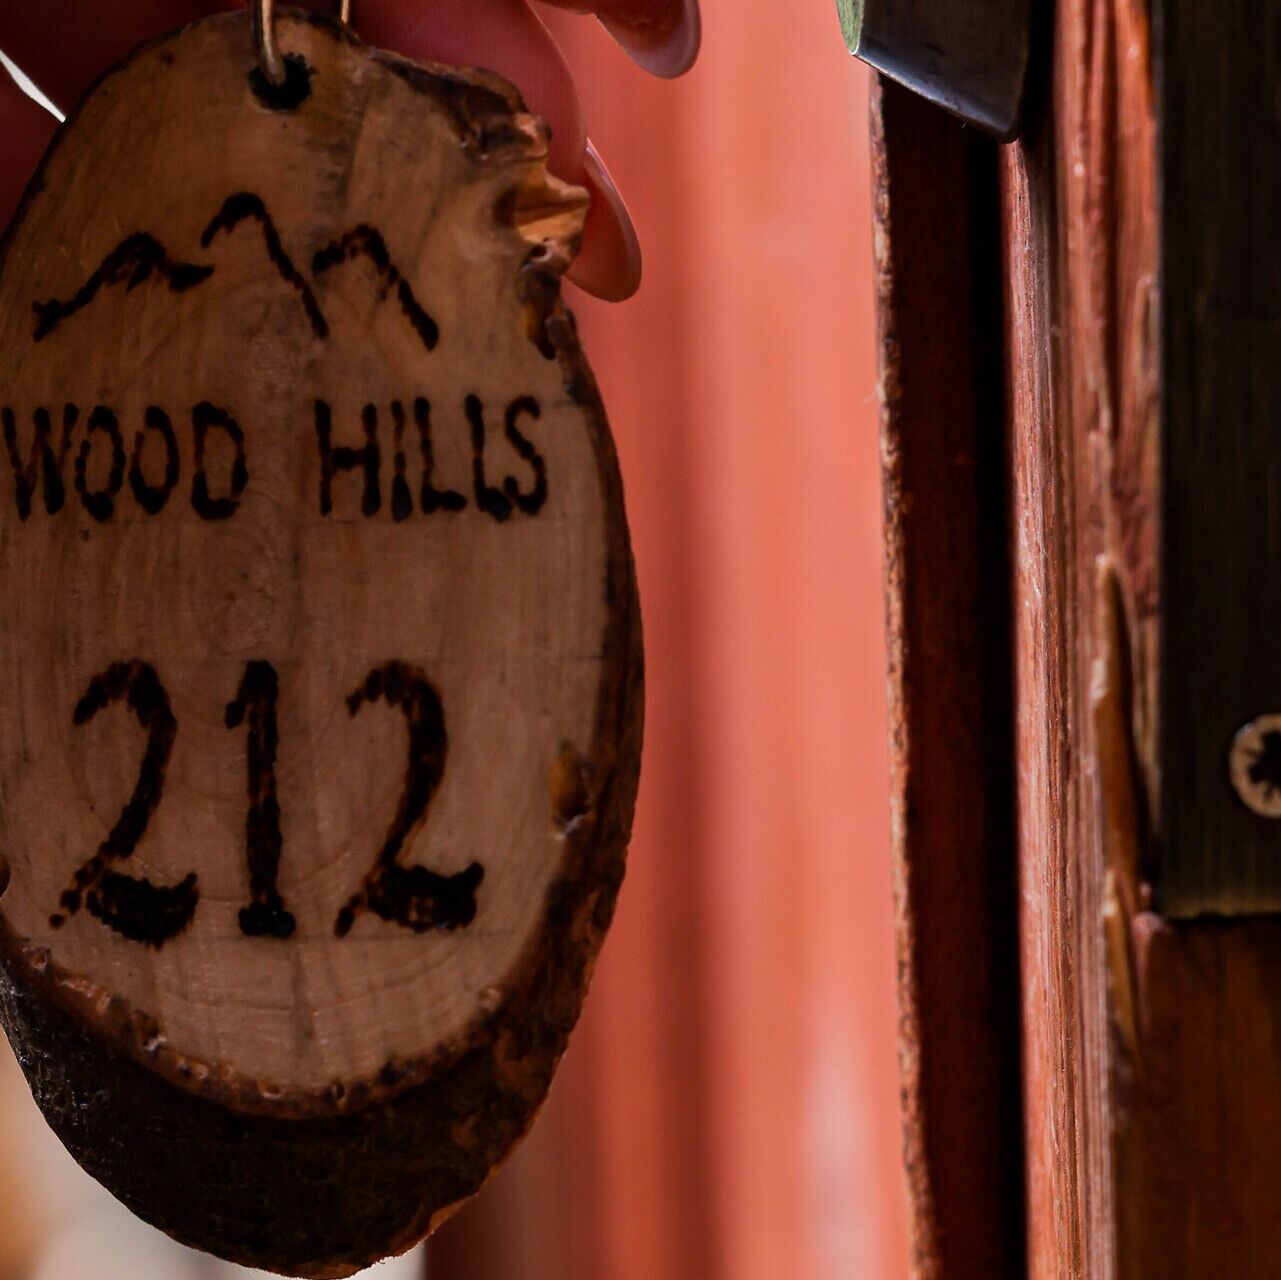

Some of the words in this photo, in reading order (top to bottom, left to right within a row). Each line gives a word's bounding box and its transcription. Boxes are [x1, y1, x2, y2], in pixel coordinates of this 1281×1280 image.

[2, 402, 248, 521] WOOD
[315, 394, 548, 520] HILLS
[49, 658, 483, 949] 212
